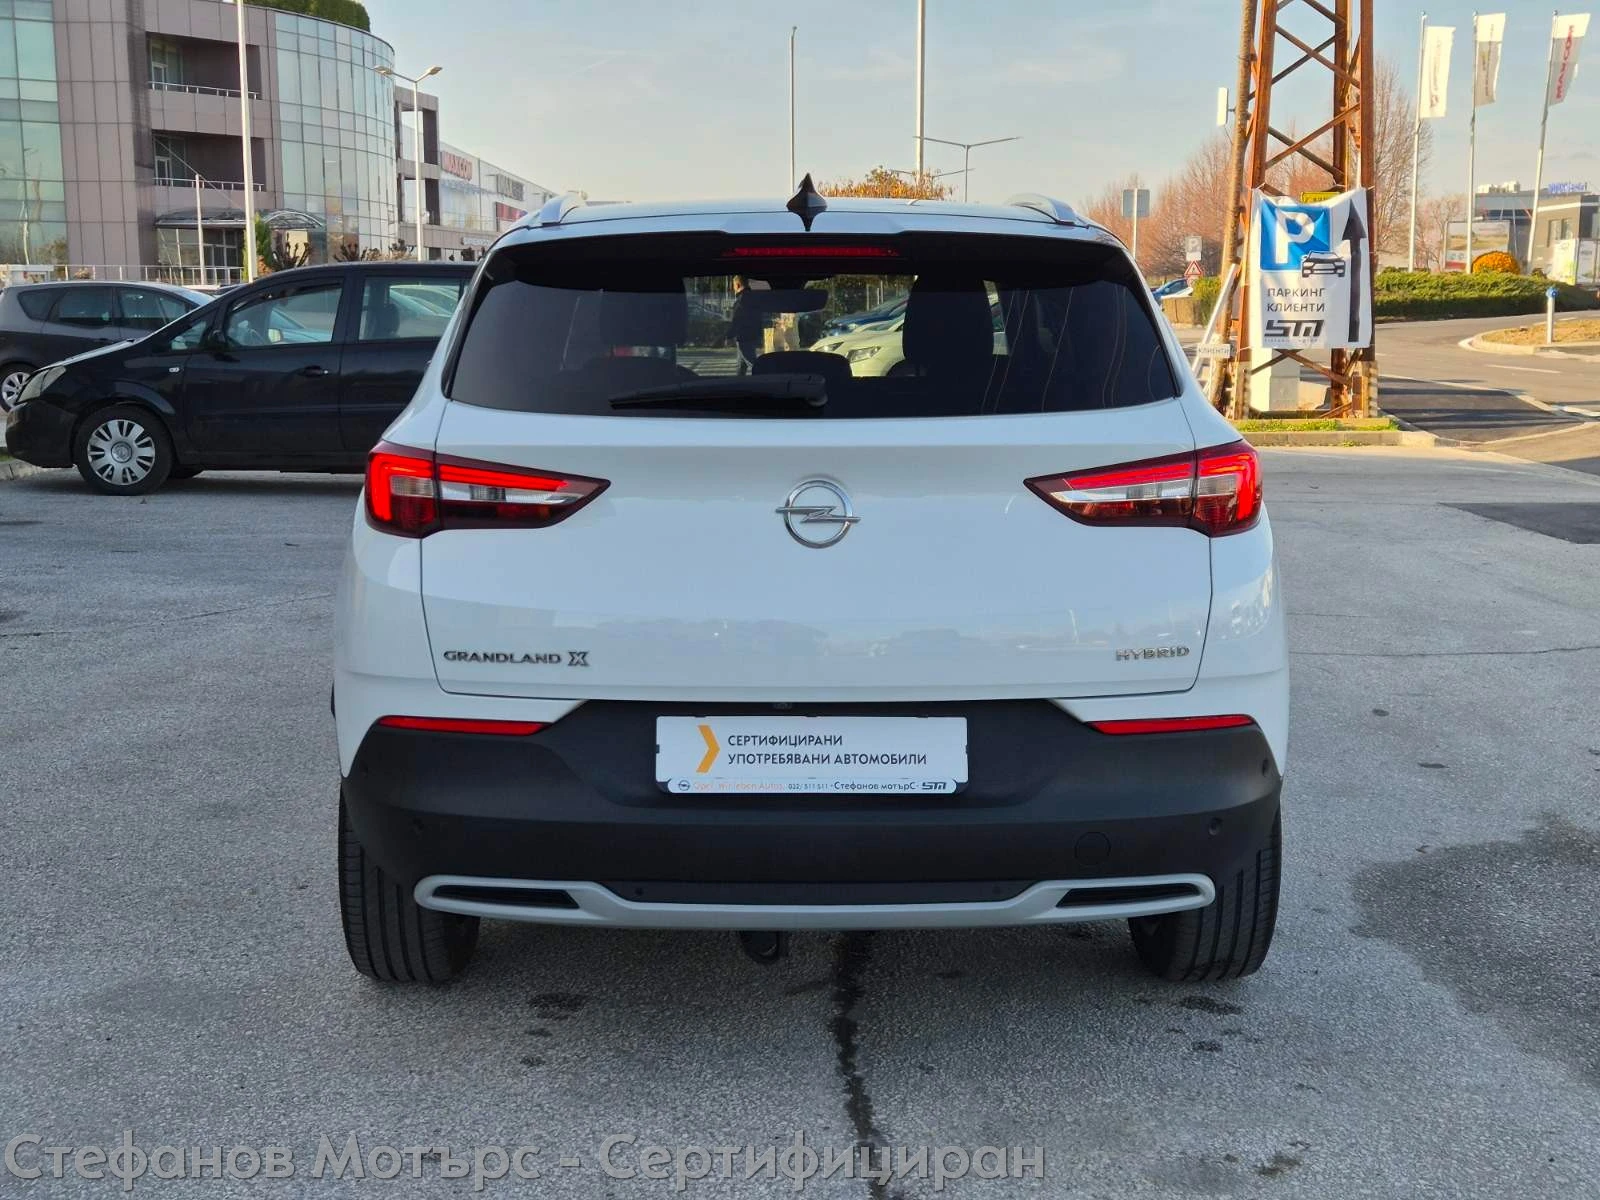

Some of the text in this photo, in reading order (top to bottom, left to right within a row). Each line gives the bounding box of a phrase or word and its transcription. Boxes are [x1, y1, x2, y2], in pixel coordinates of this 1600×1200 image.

[1275, 208, 1315, 264] P
[1267, 288, 1325, 297] ПАРКИНГ
[1267, 303, 1325, 312] КЛИЕНТИ
[443, 650, 590, 667] GRANDLAND X
[1116, 646, 1190, 661] HYBRID
[728, 735, 843, 748] СЕРТИФИЦИРАНИ
[728, 753, 927, 765] УПОТРЕБЯВАНИ АВТОМОБИЛИ
[834, 781, 879, 791] Стефанов
